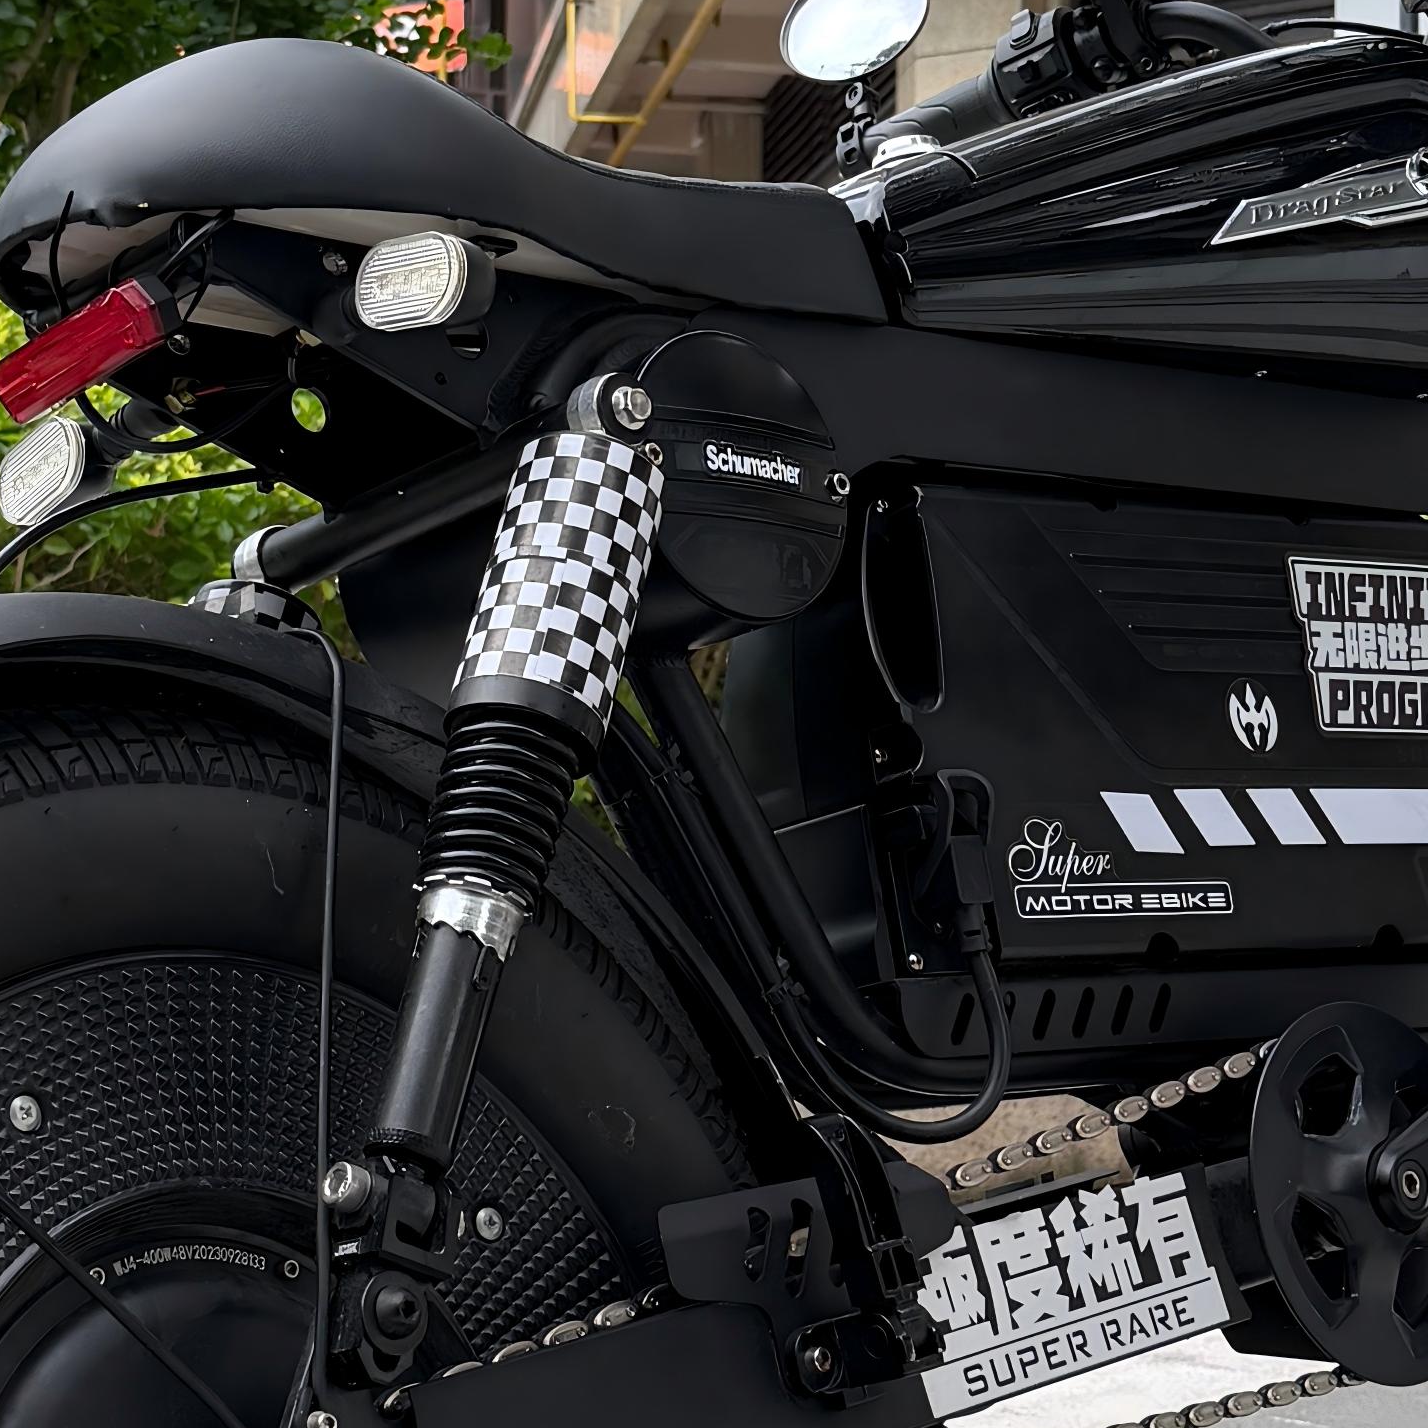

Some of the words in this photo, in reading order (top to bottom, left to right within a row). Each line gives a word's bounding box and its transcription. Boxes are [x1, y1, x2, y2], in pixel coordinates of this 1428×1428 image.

[705, 443, 801, 486] Schumacher
[1008, 818, 1111, 894] Super
[1025, 894, 1133, 912] MOTOR
[1141, 892, 1227, 909] EBIKE
[963, 1325, 1094, 1398] SUPER
[1101, 1295, 1196, 1355] RARE
